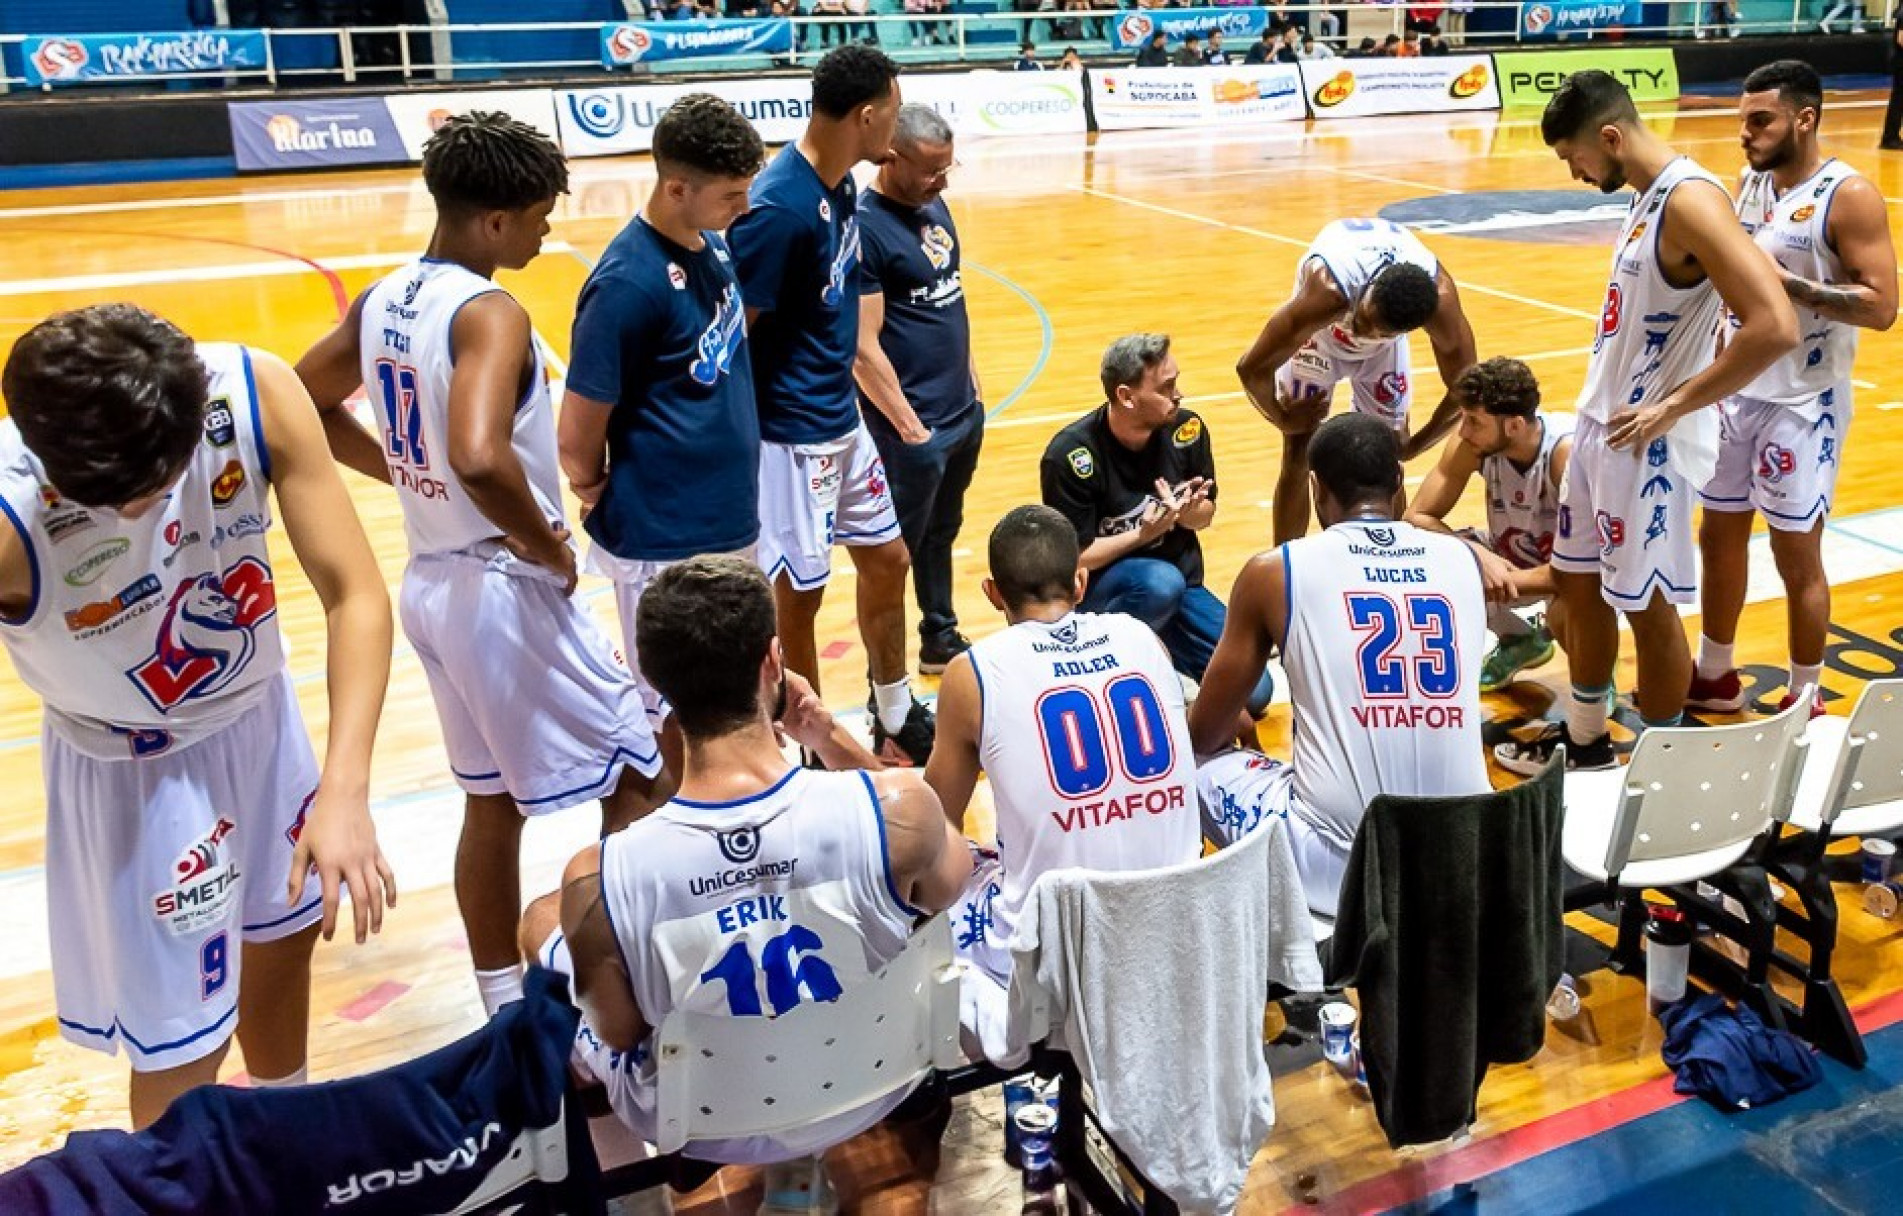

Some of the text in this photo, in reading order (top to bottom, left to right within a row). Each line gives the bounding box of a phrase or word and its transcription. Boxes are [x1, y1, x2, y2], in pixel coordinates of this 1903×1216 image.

[1510, 69, 1664, 93] PETY
[985, 99, 1072, 117] COOPERESO
[1364, 566, 1427, 583] LUCAS
[1343, 591, 1462, 700] 23
[1053, 653, 1119, 678] ADLER
[1034, 672, 1176, 801] 00
[1351, 705, 1464, 729] VITAFOR
[1052, 785, 1185, 832] VITAFOR
[689, 857, 799, 896] UniCesumar
[716, 895, 788, 934] ERIK
[200, 928, 228, 1002] 9
[700, 924, 844, 1018] 16
[326, 1122, 501, 1205] VAFOR
